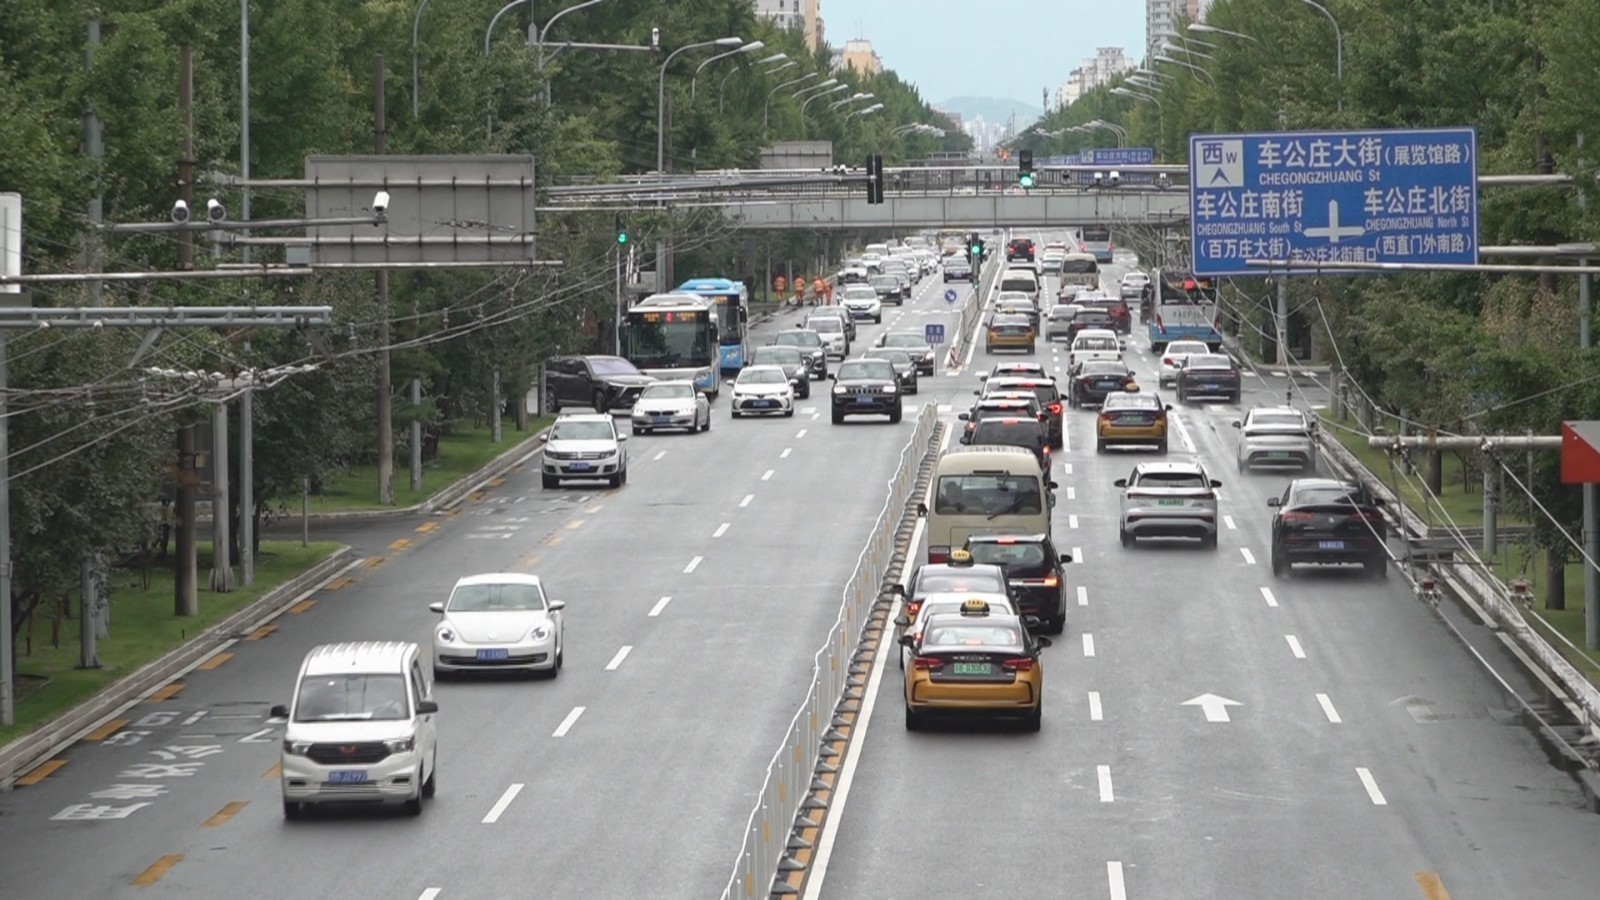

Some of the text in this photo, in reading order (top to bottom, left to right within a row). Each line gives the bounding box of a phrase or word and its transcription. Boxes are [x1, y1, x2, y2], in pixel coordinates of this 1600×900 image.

[1201, 142, 1223, 165] 西
[1226, 152, 1237, 164] W
[1258, 138, 1382, 169] 车公庄大街
[1259, 169, 1381, 186] CHEGONGZHUANG St
[1197, 189, 1303, 219] 车公庄南街
[1364, 185, 1471, 216] 车公庄北街
[1197, 221, 1302, 236] CHEGONGZHUANG South St
[1366, 216, 1433, 231] CHEGONGZHUANG
[1438, 215, 1457, 228] North
